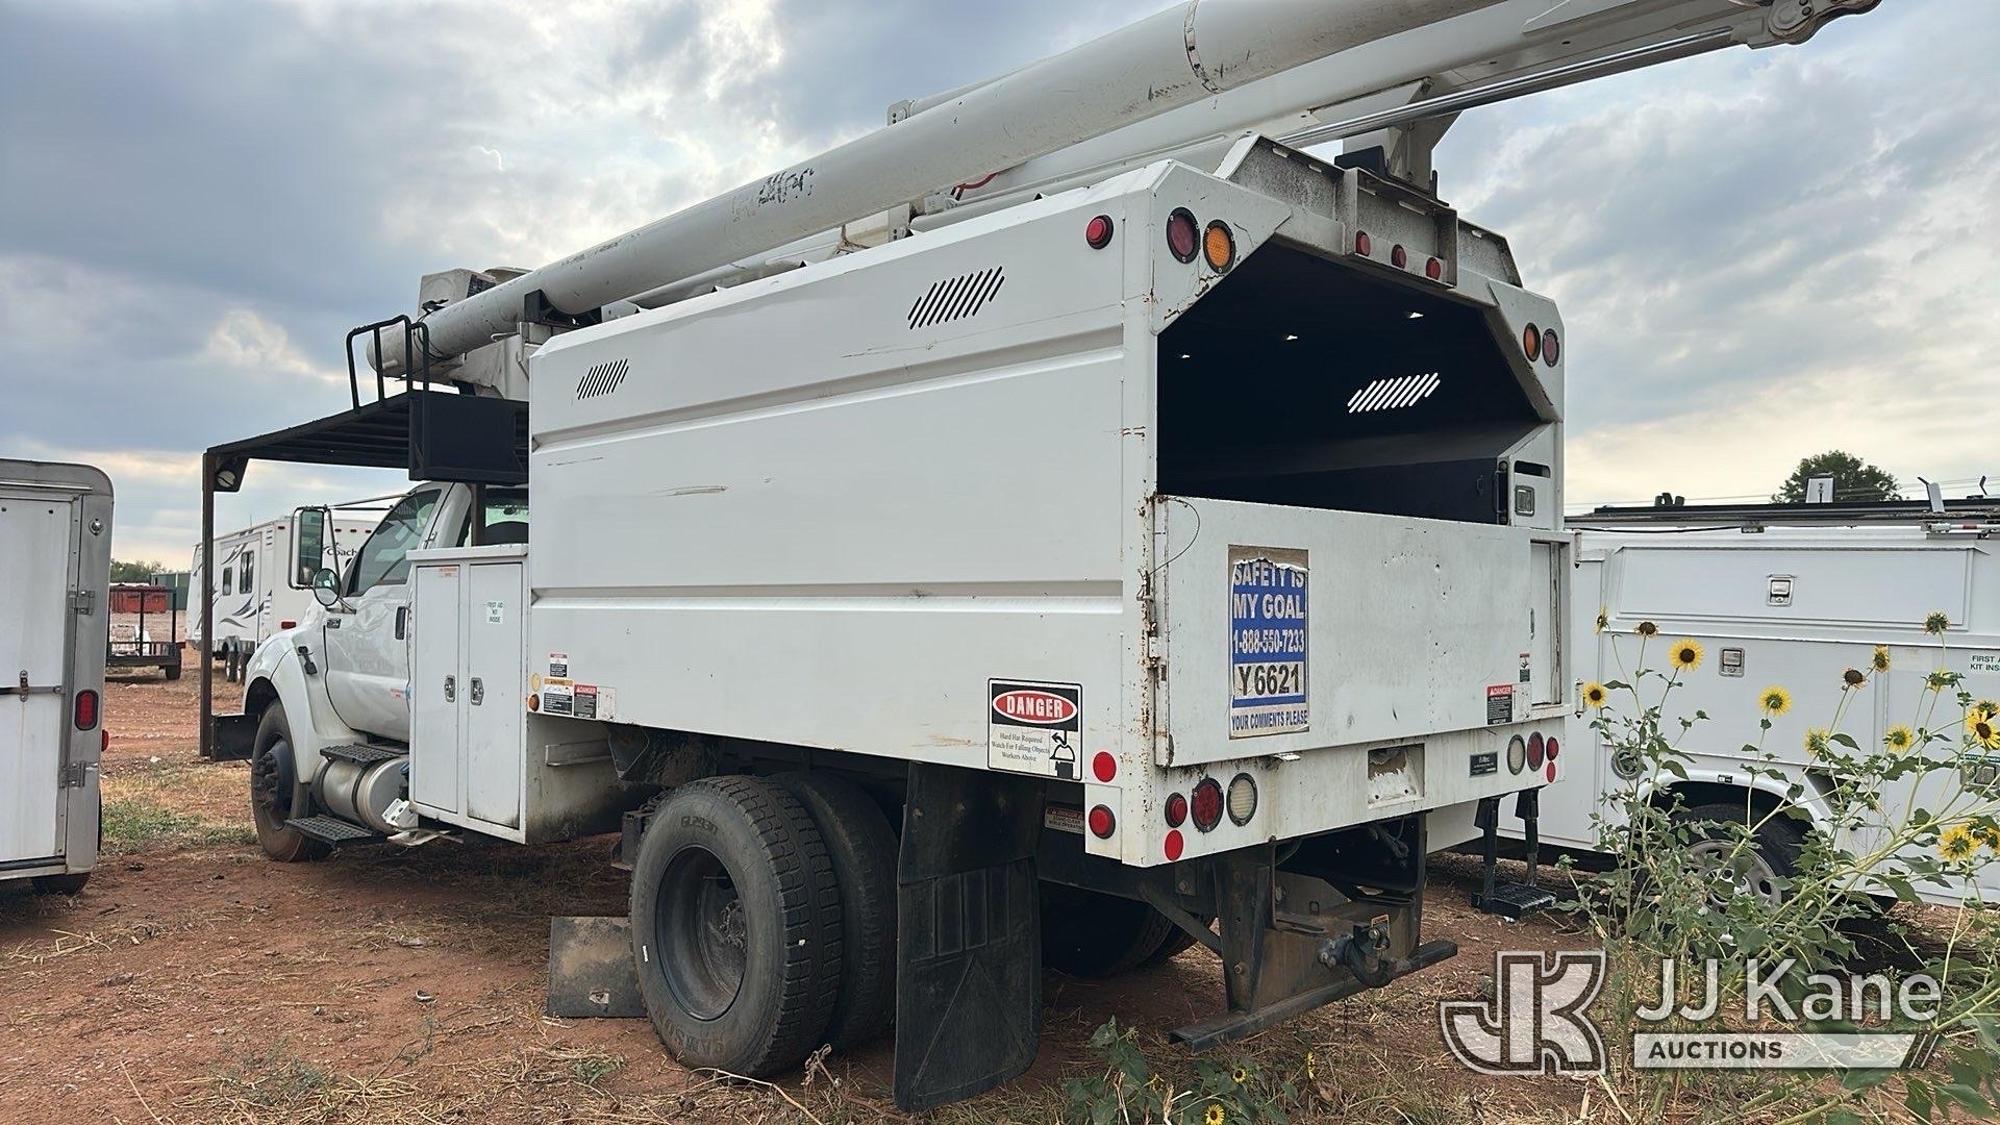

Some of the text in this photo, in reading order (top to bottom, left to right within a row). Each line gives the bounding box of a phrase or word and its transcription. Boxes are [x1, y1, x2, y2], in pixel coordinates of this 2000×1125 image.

[1234, 561, 1304, 588] SAFETY IS
[1234, 593, 1305, 620] MY GOAL
[1233, 628, 1305, 654] 1-888-550-7233
[1972, 655, 1995, 663] FIRST
[1238, 663, 1299, 696] Y6621
[1006, 695, 1063, 718] DANGER
[1232, 709, 1308, 731] YOUR COMMENTS PLEASE
[991, 741, 1005, 749] Watch
[1000, 732, 1043, 744] Hard Hat Required
[1002, 751, 1036, 762] Workers Above
